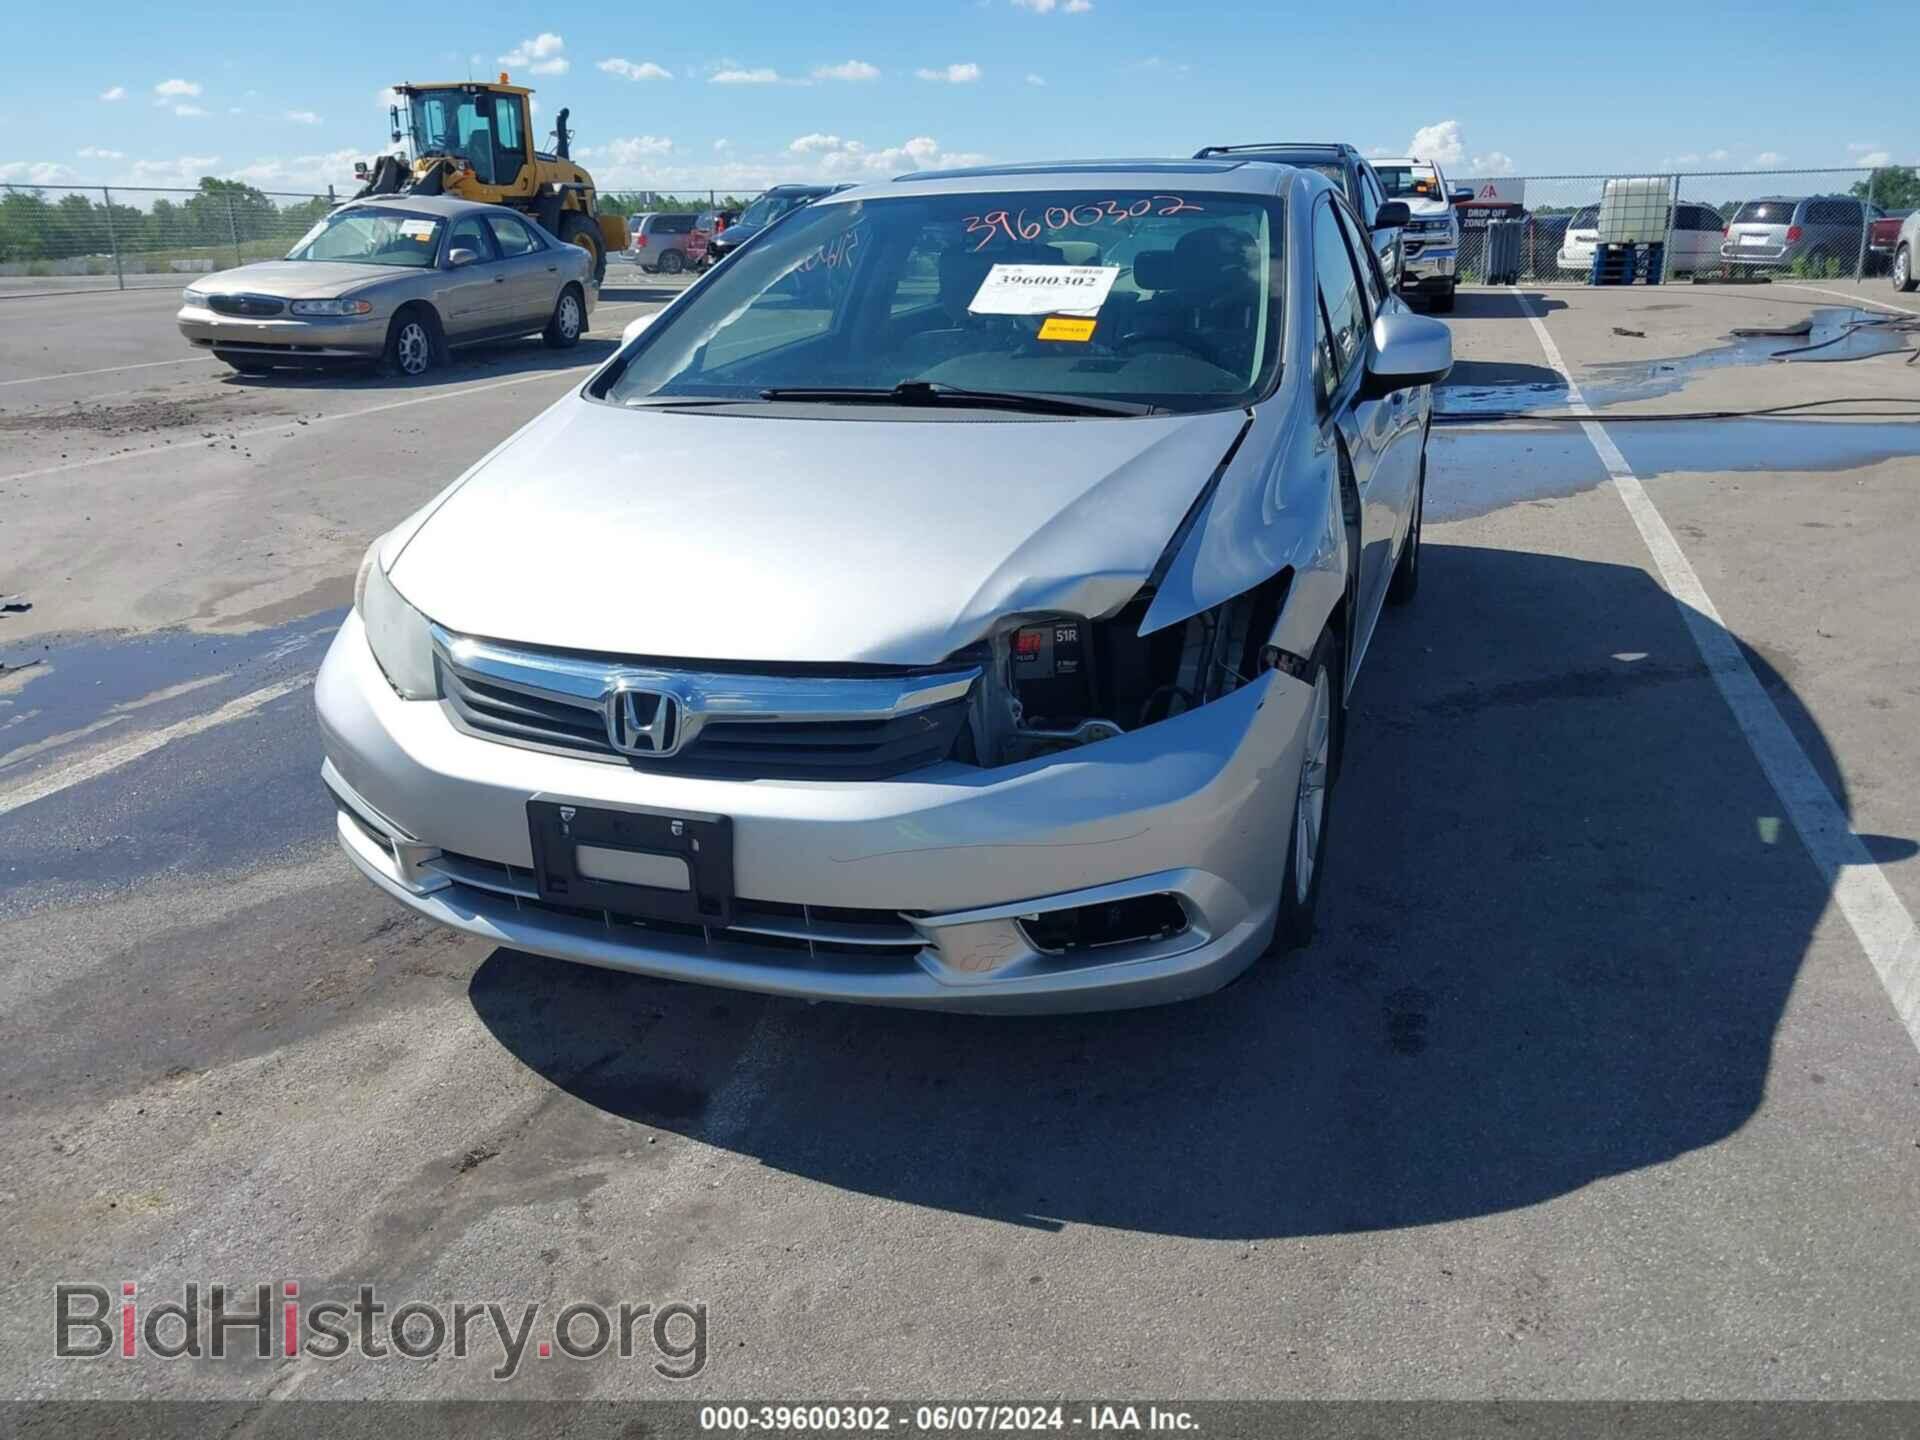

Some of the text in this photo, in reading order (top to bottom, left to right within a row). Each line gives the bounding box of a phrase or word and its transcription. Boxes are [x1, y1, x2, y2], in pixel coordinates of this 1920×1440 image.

[1467, 208, 1507, 217] DROP OFF
[962, 195, 1204, 252] 39600302
[1000, 275, 1097, 287] 39600302
[1056, 629, 1078, 642] 51R
